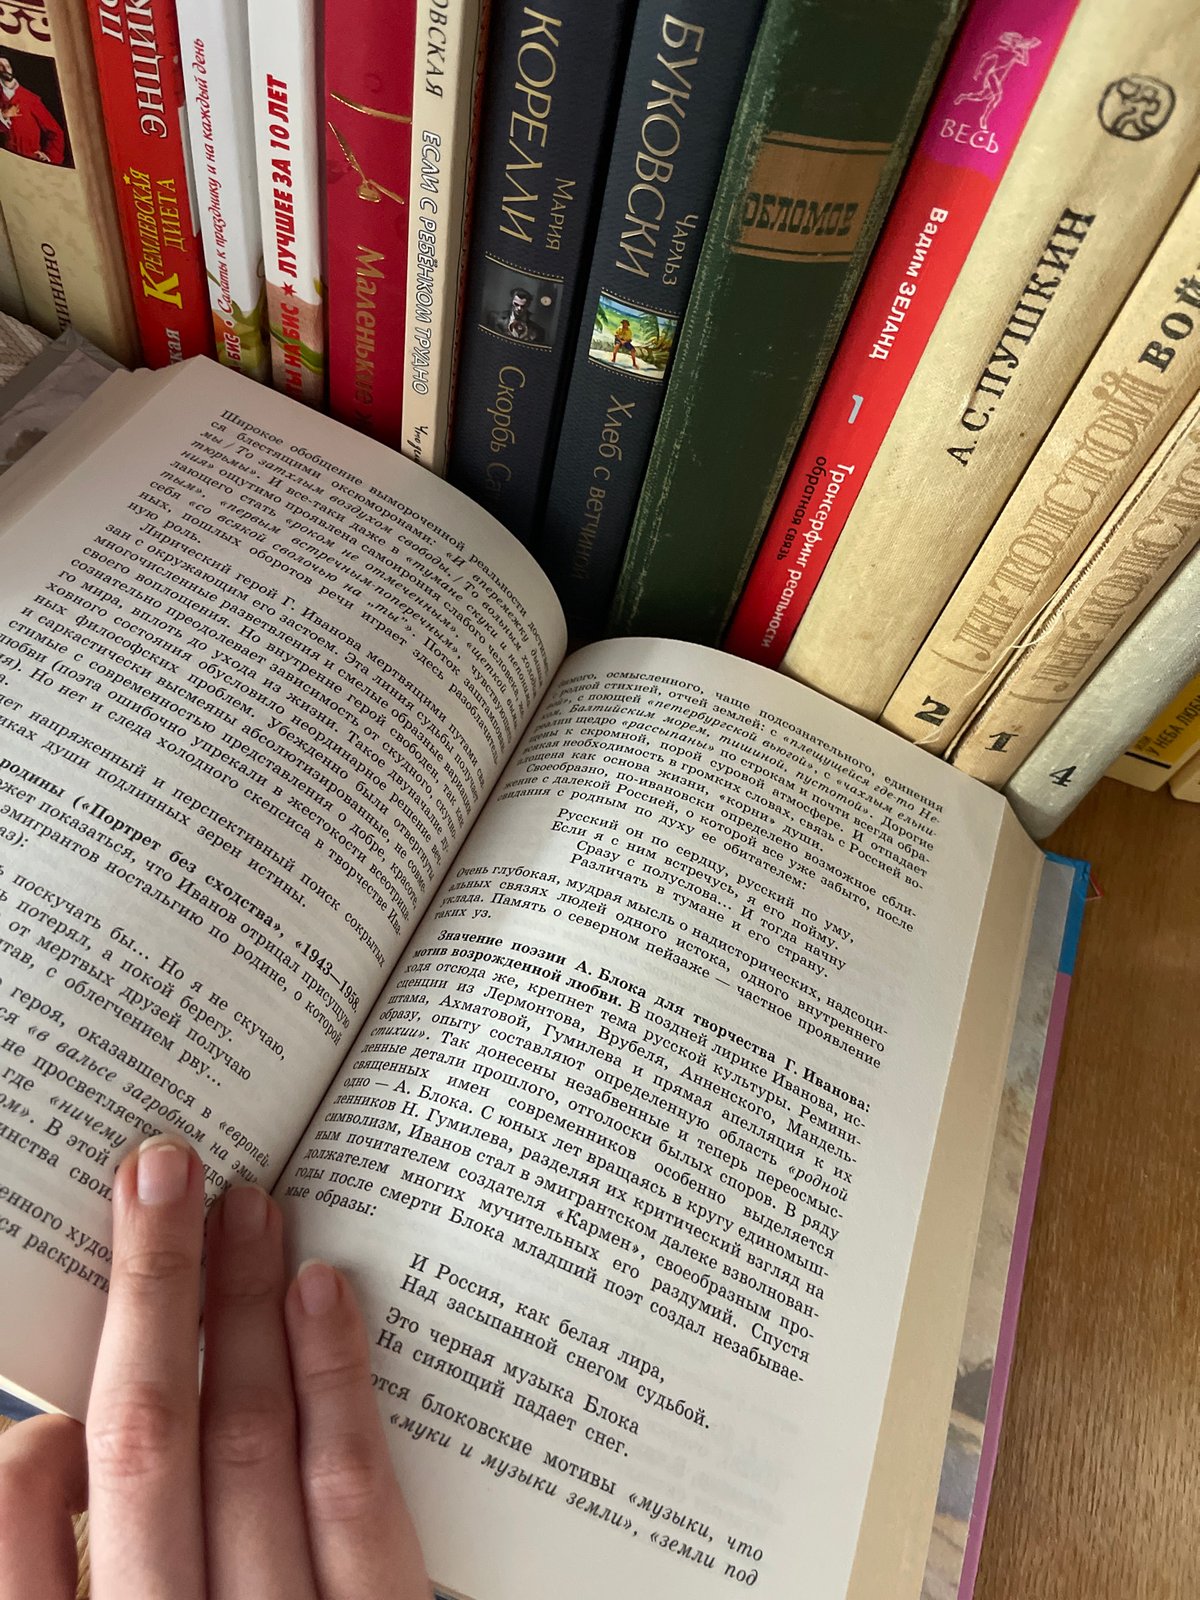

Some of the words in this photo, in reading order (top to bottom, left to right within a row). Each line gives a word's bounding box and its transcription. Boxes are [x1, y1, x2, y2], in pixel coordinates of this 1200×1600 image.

[192, 38, 207, 75] день
[194, 75, 213, 141] каждый
[266, 73, 290, 124] ЛЕТ
[499, 6, 562, 243] КОРЕЛЛИ
[205, 143, 216, 162] на
[208, 164, 217, 174] и
[269, 124, 291, 151] 10
[271, 158, 293, 188] ЗА
[420, 130, 441, 193] ЕСЛИ
[616, 13, 705, 278] БУКОВСКИ
[157, 178, 186, 252] ДИЕТА
[206, 177, 228, 248] празднику
[273, 188, 298, 278] ЛУЧШЕЕ
[420, 198, 437, 214] С
[742, 192, 859, 237] ОБЛОМОВ
[215, 250, 227, 260] к
[415, 217, 438, 325] РЕБЁНКОМ
[662, 214, 699, 286] ЧАРЛЬЗ
[906, 207, 949, 277] Вадим
[217, 262, 232, 313] Салаты
[280, 303, 300, 341] БИС
[869, 281, 917, 360] ЗЕЛАНД
[976, 207, 1096, 400] ПУШКИН
[1138, 264, 1200, 373] ВОЙ
[224, 333, 241, 361] БИС
[284, 343, 302, 366] НА
[411, 327, 432, 396] ТРУДНО
[486, 365, 526, 453] Скорбь
[598, 394, 636, 461] Хлеб
[848, 394, 864, 424] 1
[593, 465, 611, 481] с
[791, 456, 827, 526] обратная
[220, 409, 284, 445] Широкое
[290, 445, 363, 486] обобщение
[368, 486, 465, 552] вымороченной
[468, 554, 527, 618] реальности
[776, 526, 798, 561] связь
[796, 463, 855, 568] Трансерфинг
[139, 525, 232, 575] Лирический
[234, 572, 278, 600] герой
[761, 568, 802, 648] реальности
[606, 672, 704, 695] осмысленного,
[716, 692, 750, 711] чаще
[758, 709, 875, 777] подсознательного,
[884, 776, 943, 813] единения
[914, 695, 951, 726] 2
[984, 731, 1018, 753] 1
[1155, 724, 1185, 749] НЕБА
[1049, 765, 1077, 787] 4
[169, 850, 197, 874] без
[556, 808, 619, 831] Русский
[625, 827, 644, 839] он
[650, 836, 669, 848] по
[676, 846, 729, 877] сердцу,
[736, 874, 795, 910] русский
[801, 907, 818, 922] по
[823, 919, 854, 944] уму,
[12, 874, 101, 930] поскучать
[158, 955, 184, 980] Но
[190, 981, 204, 993] я
[208, 992, 228, 1011] не
[233, 1011, 284, 1061] скучаю,
[10, 987, 65, 1028] героя,
[78, 1026, 196, 1108] оказавшегося
[200, 1106, 212, 1119] в
[439, 930, 503, 947] Значение
[510, 942, 567, 966] поэзии
[574, 960, 592, 976] А.
[597, 967, 646, 999] Блока
[653, 996, 685, 1017] для
[693, 1013, 775, 1063] творчества
[784, 1057, 797, 1075] Г.
[802, 1066, 868, 1111] Иванова:
[483, 986, 585, 1033] Лермонтова,
[596, 1025, 668, 1071] Врубеля,
[679, 1066, 775, 1125] Анненского,
[786, 1117, 856, 1163] Мандель-
[344, 1077, 371, 1089] одно
[392, 1079, 410, 1095] А.
[417, 1084, 472, 1114] Блока.
[481, 1105, 495, 1120] С
[497, 1115, 548, 1143] юных
[552, 1138, 583, 1157] лет
[586, 1152, 667, 1198] вращаясь
[671, 1193, 682, 1205] в
[686, 1200, 735, 1232] кругу
[738, 1226, 829, 1277] единомыш-
[294, 1167, 325, 1181] годы
[328, 1171, 374, 1192] после
[380, 1186, 443, 1216] смерти
[448, 1206, 504, 1243] Блока
[512, 1237, 598, 1284] младший
[603, 1279, 644, 1305] поэт
[650, 1301, 706, 1337] создал
[712, 1331, 804, 1382] незабывае-
[399, 1273, 439, 1306] Над
[446, 1297, 558, 1356] засыпанной
[566, 1351, 629, 1389] снегом
[636, 1384, 709, 1429] судьбой.
[412, 1252, 429, 1269] И
[437, 1263, 504, 1305] Россия,
[515, 1302, 550, 1326] как
[559, 1319, 610, 1354] белая
[617, 1350, 664, 1384] лира,
[375, 1328, 403, 1354] На
[412, 1349, 505, 1399] сияющий
[512, 1393, 577, 1431] падает
[585, 1427, 629, 1456] снег.
[386, 1306, 419, 1333] Это
[430, 1328, 496, 1367] черная
[503, 1362, 574, 1404] музыка
[582, 1393, 639, 1435] Блока
[390, 1413, 452, 1448] «муки
[460, 1443, 473, 1458] и
[481, 1454, 558, 1496] музыки
[566, 1492, 637, 1537] земли»,
[650, 1532, 715, 1569] «земли
[724, 1564, 758, 1586] под
[421, 1393, 532, 1456] блоковские
[542, 1451, 617, 1495] мотивы
[629, 1493, 713, 1542] «музыки,
[727, 1536, 763, 1561] что
